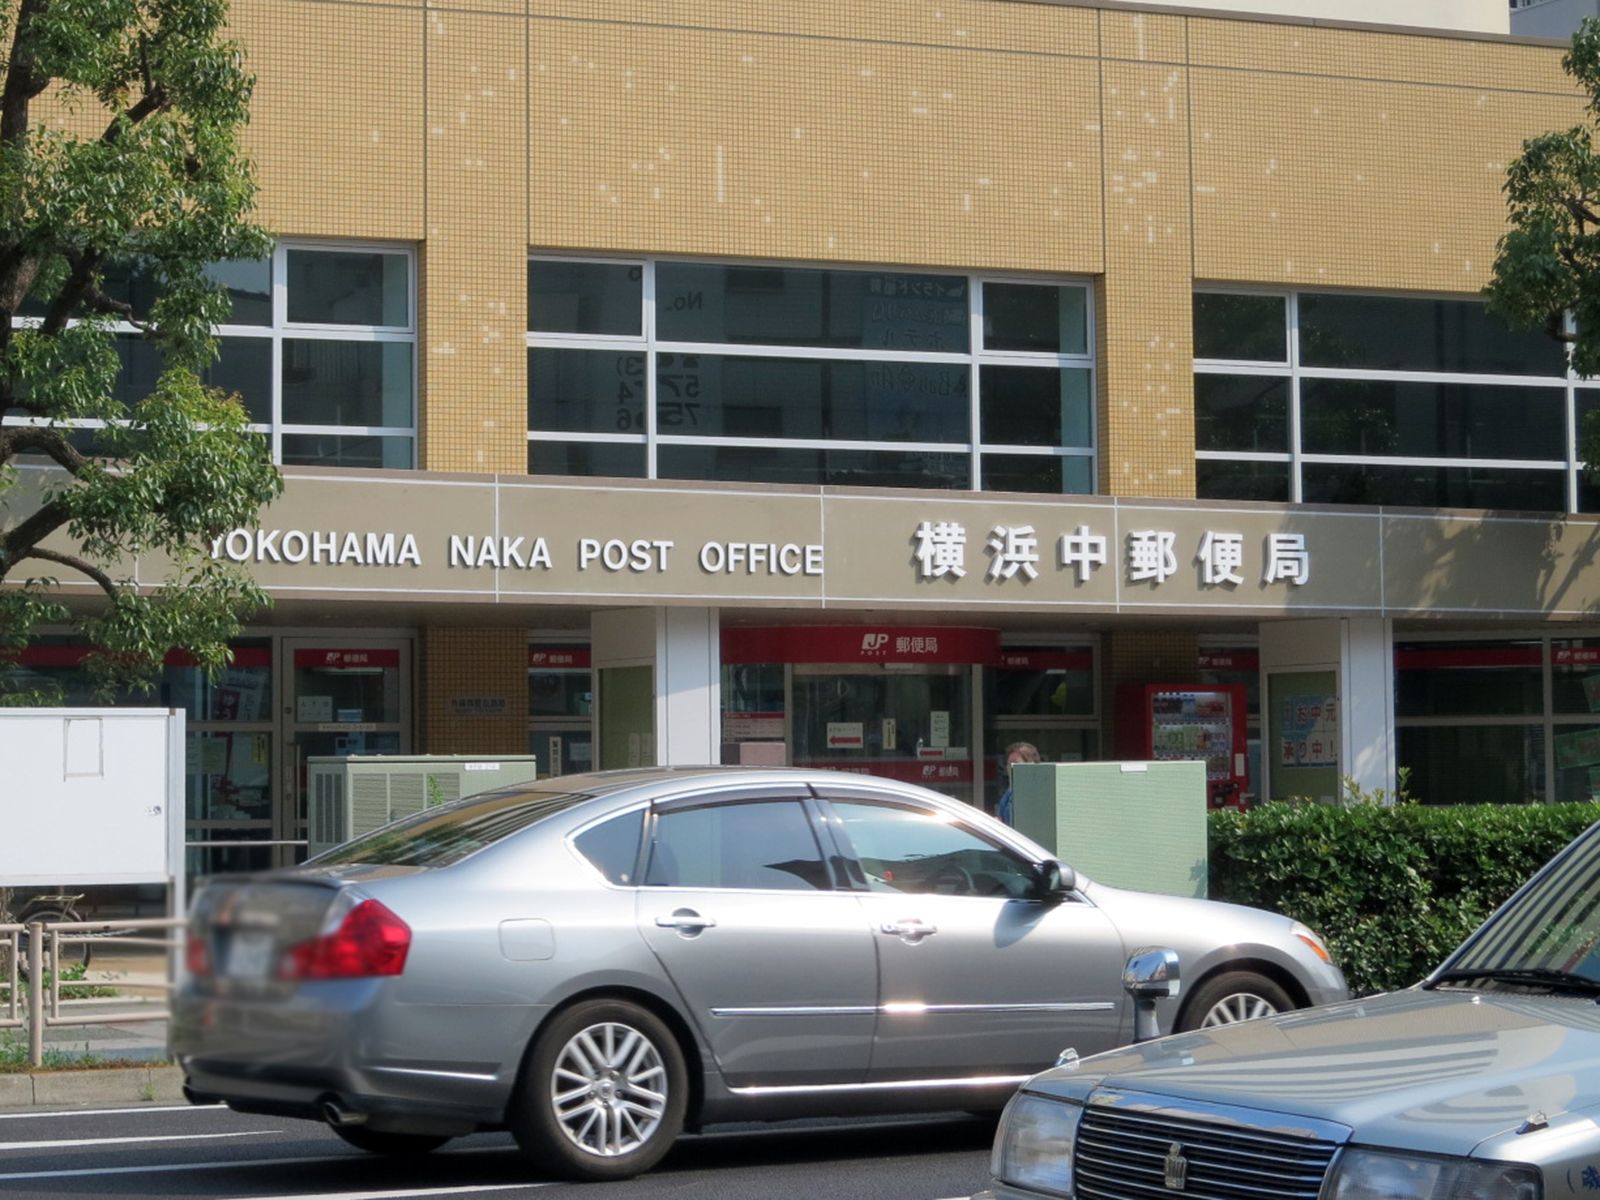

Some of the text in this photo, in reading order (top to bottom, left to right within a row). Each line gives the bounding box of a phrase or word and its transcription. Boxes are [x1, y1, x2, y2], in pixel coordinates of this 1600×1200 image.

[210, 528, 824, 576] YOKOHAMA NAKA POST OFFICE
[914, 520, 1311, 586] 横浜中郵便局
[861, 633, 939, 654] JP 郵便局
